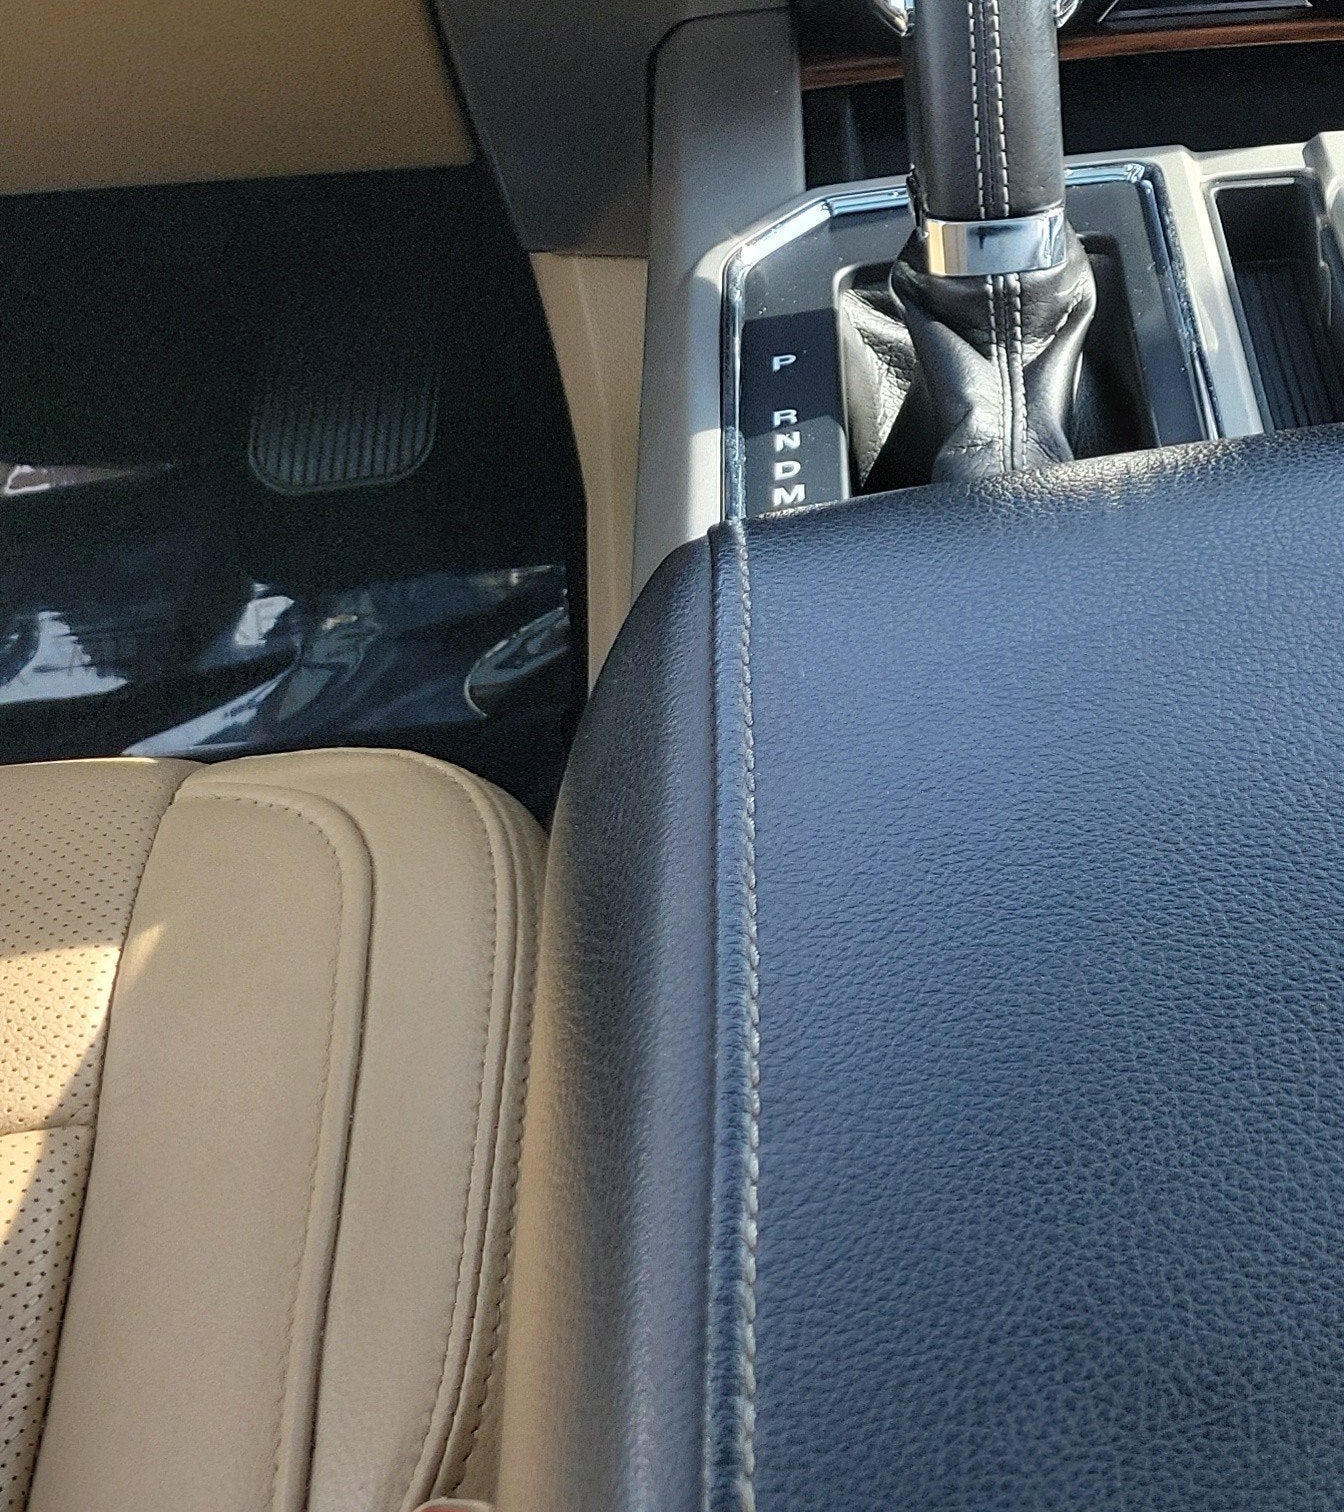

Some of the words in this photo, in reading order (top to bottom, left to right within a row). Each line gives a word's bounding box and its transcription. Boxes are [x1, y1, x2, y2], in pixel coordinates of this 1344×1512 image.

[772, 354, 797, 372] P
[773, 409, 798, 428] R
[775, 431, 800, 452] N
[774, 460, 801, 481] D
[773, 484, 806, 507] M
